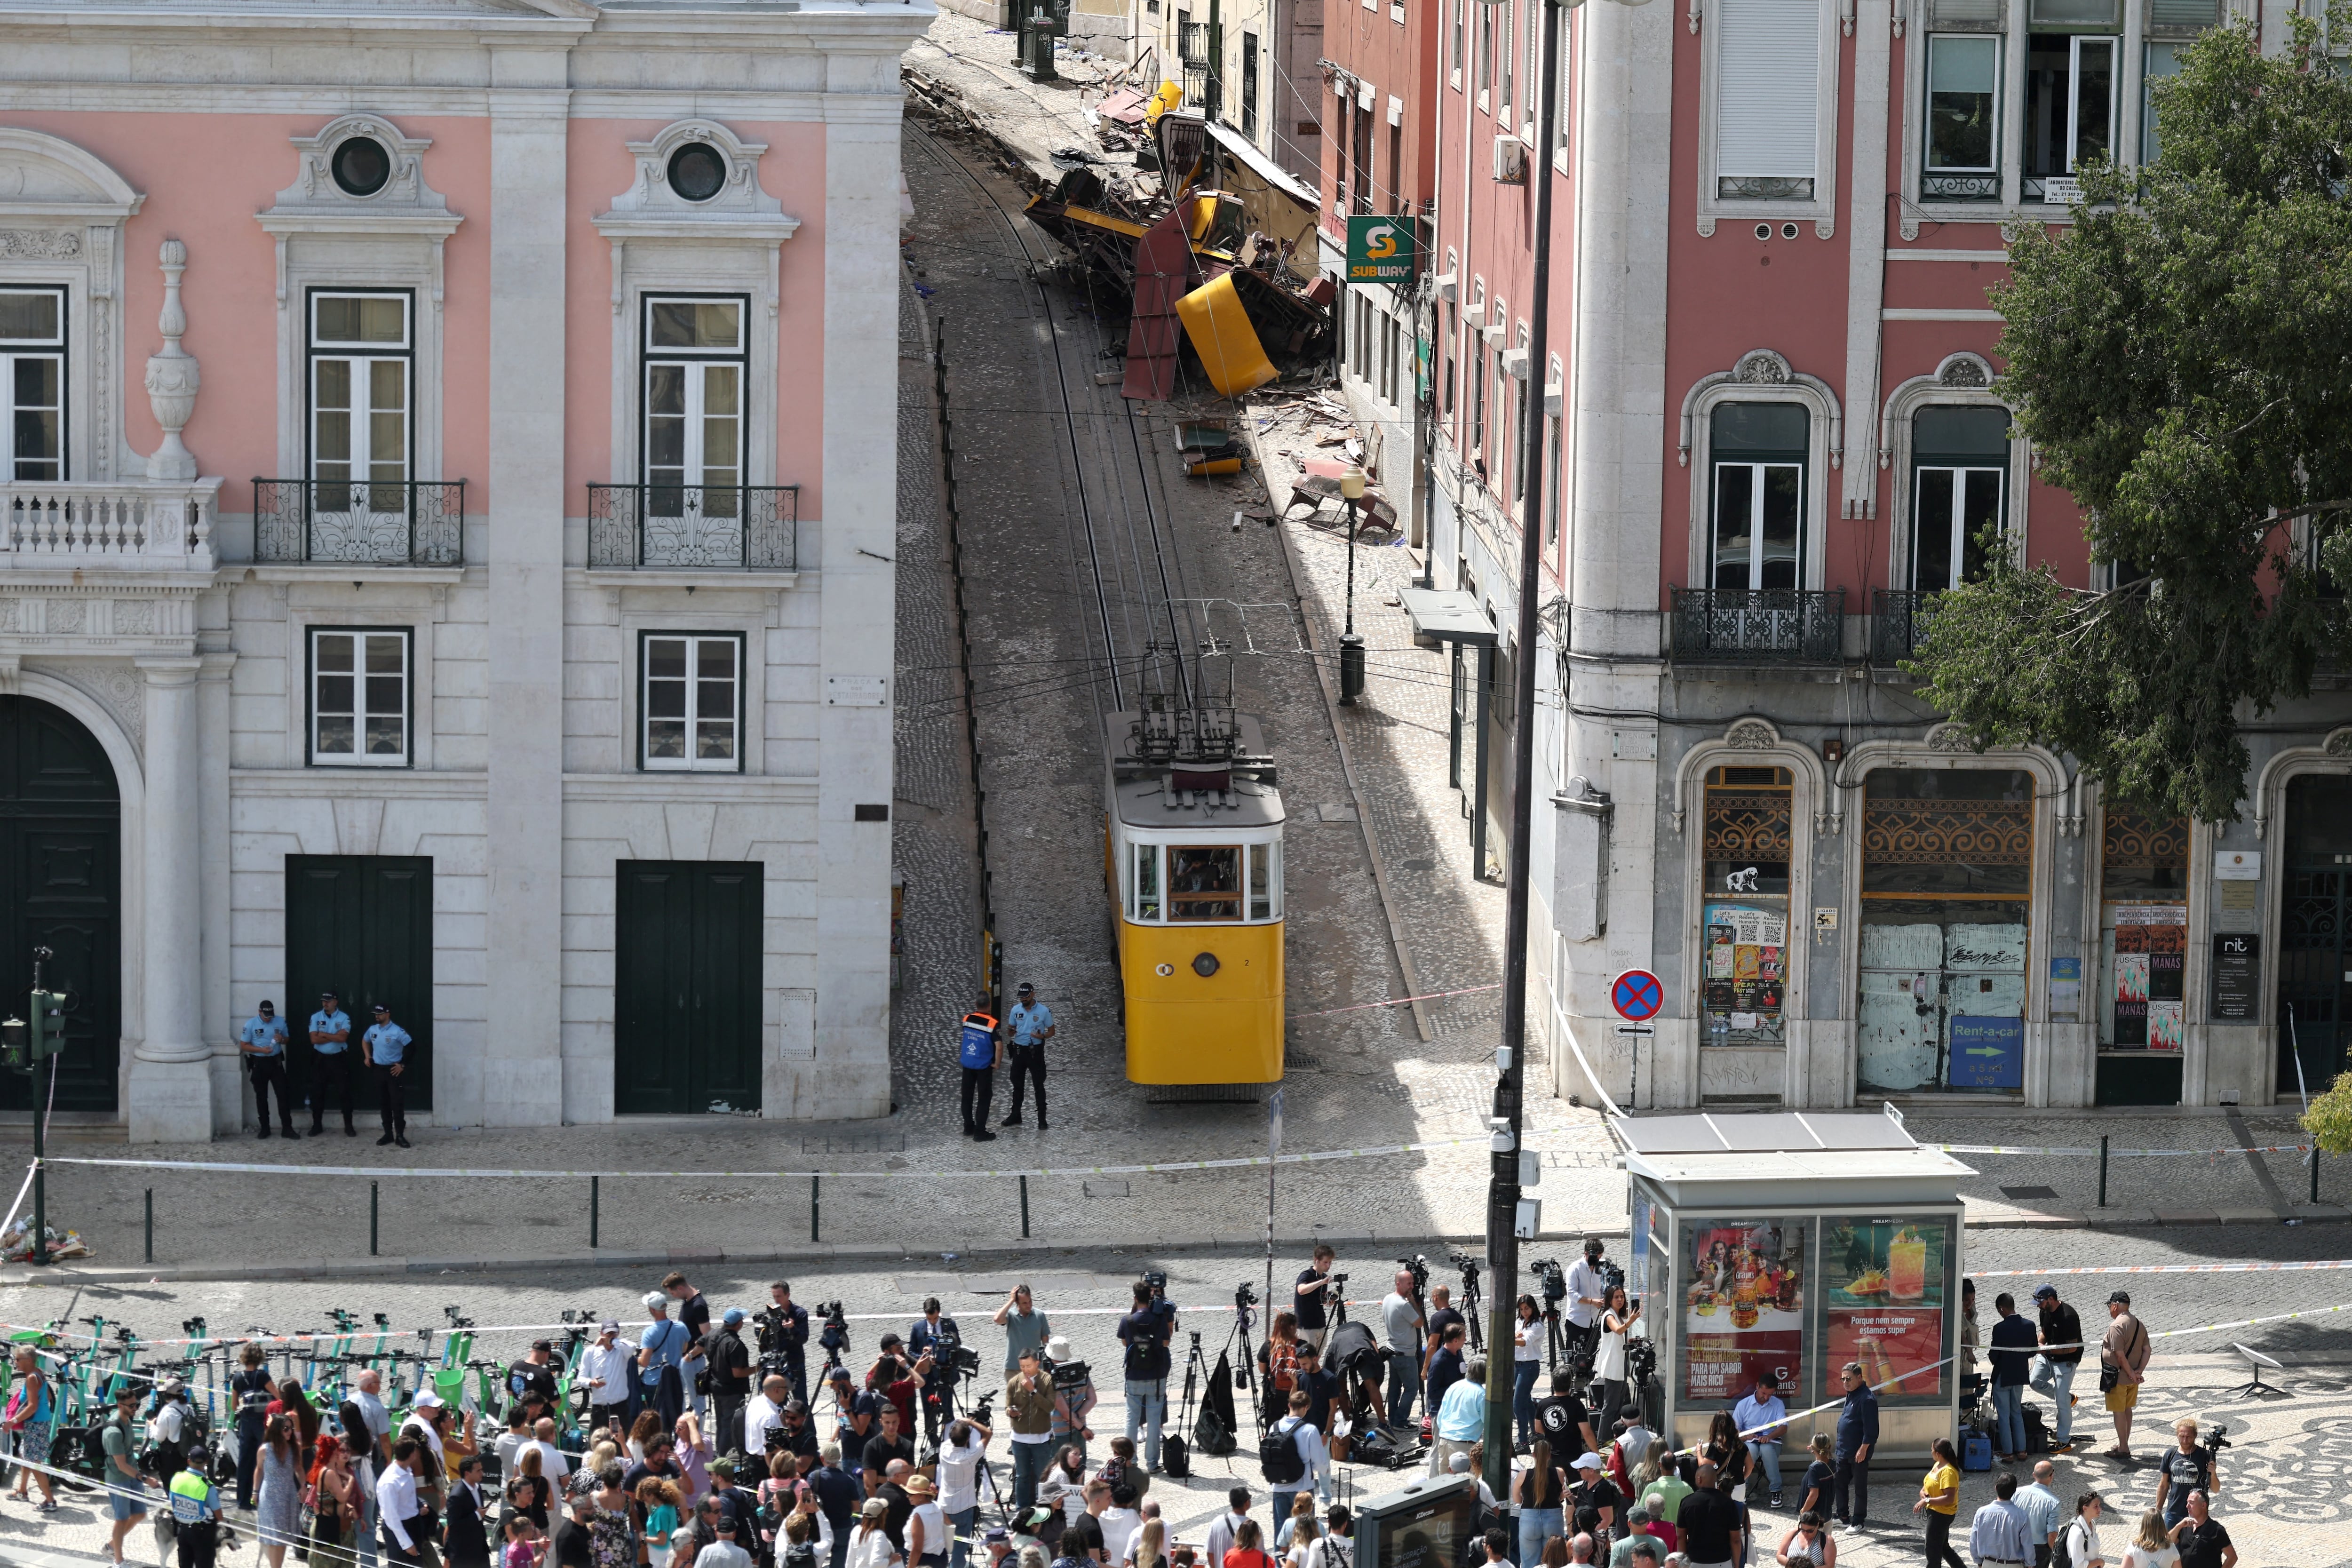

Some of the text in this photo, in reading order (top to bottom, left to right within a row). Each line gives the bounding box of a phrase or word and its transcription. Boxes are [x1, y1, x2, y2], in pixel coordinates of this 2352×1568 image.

[1350, 266, 1411, 278] SUBWAY
[2225, 938, 2247, 952] rit
[2153, 957, 2181, 969] MANAS
[2118, 1005, 2145, 1016] MANAS
[1955, 1025, 2019, 1036] Rent-a-car
[1979, 1064, 1985, 1073] 5
[1851, 1317, 1874, 1326] Porque
[1891, 1317, 1915, 1326] sempre
[1692, 1339, 1732, 1350] ENVELHECIDO
[1692, 1349, 1741, 1362] EM TRÊS BARRIS
[1691, 1362, 1742, 1375] PARA UM SABOR
[1691, 1374, 1724, 1387] MAIS RICO
[1777, 1380, 1796, 1390] ant's
[1415, 1509, 1434, 1520] JCDecaux
[1402, 1546, 1427, 1560] CORAÇÃO
[1402, 1559, 1421, 1568] BAIRRO
